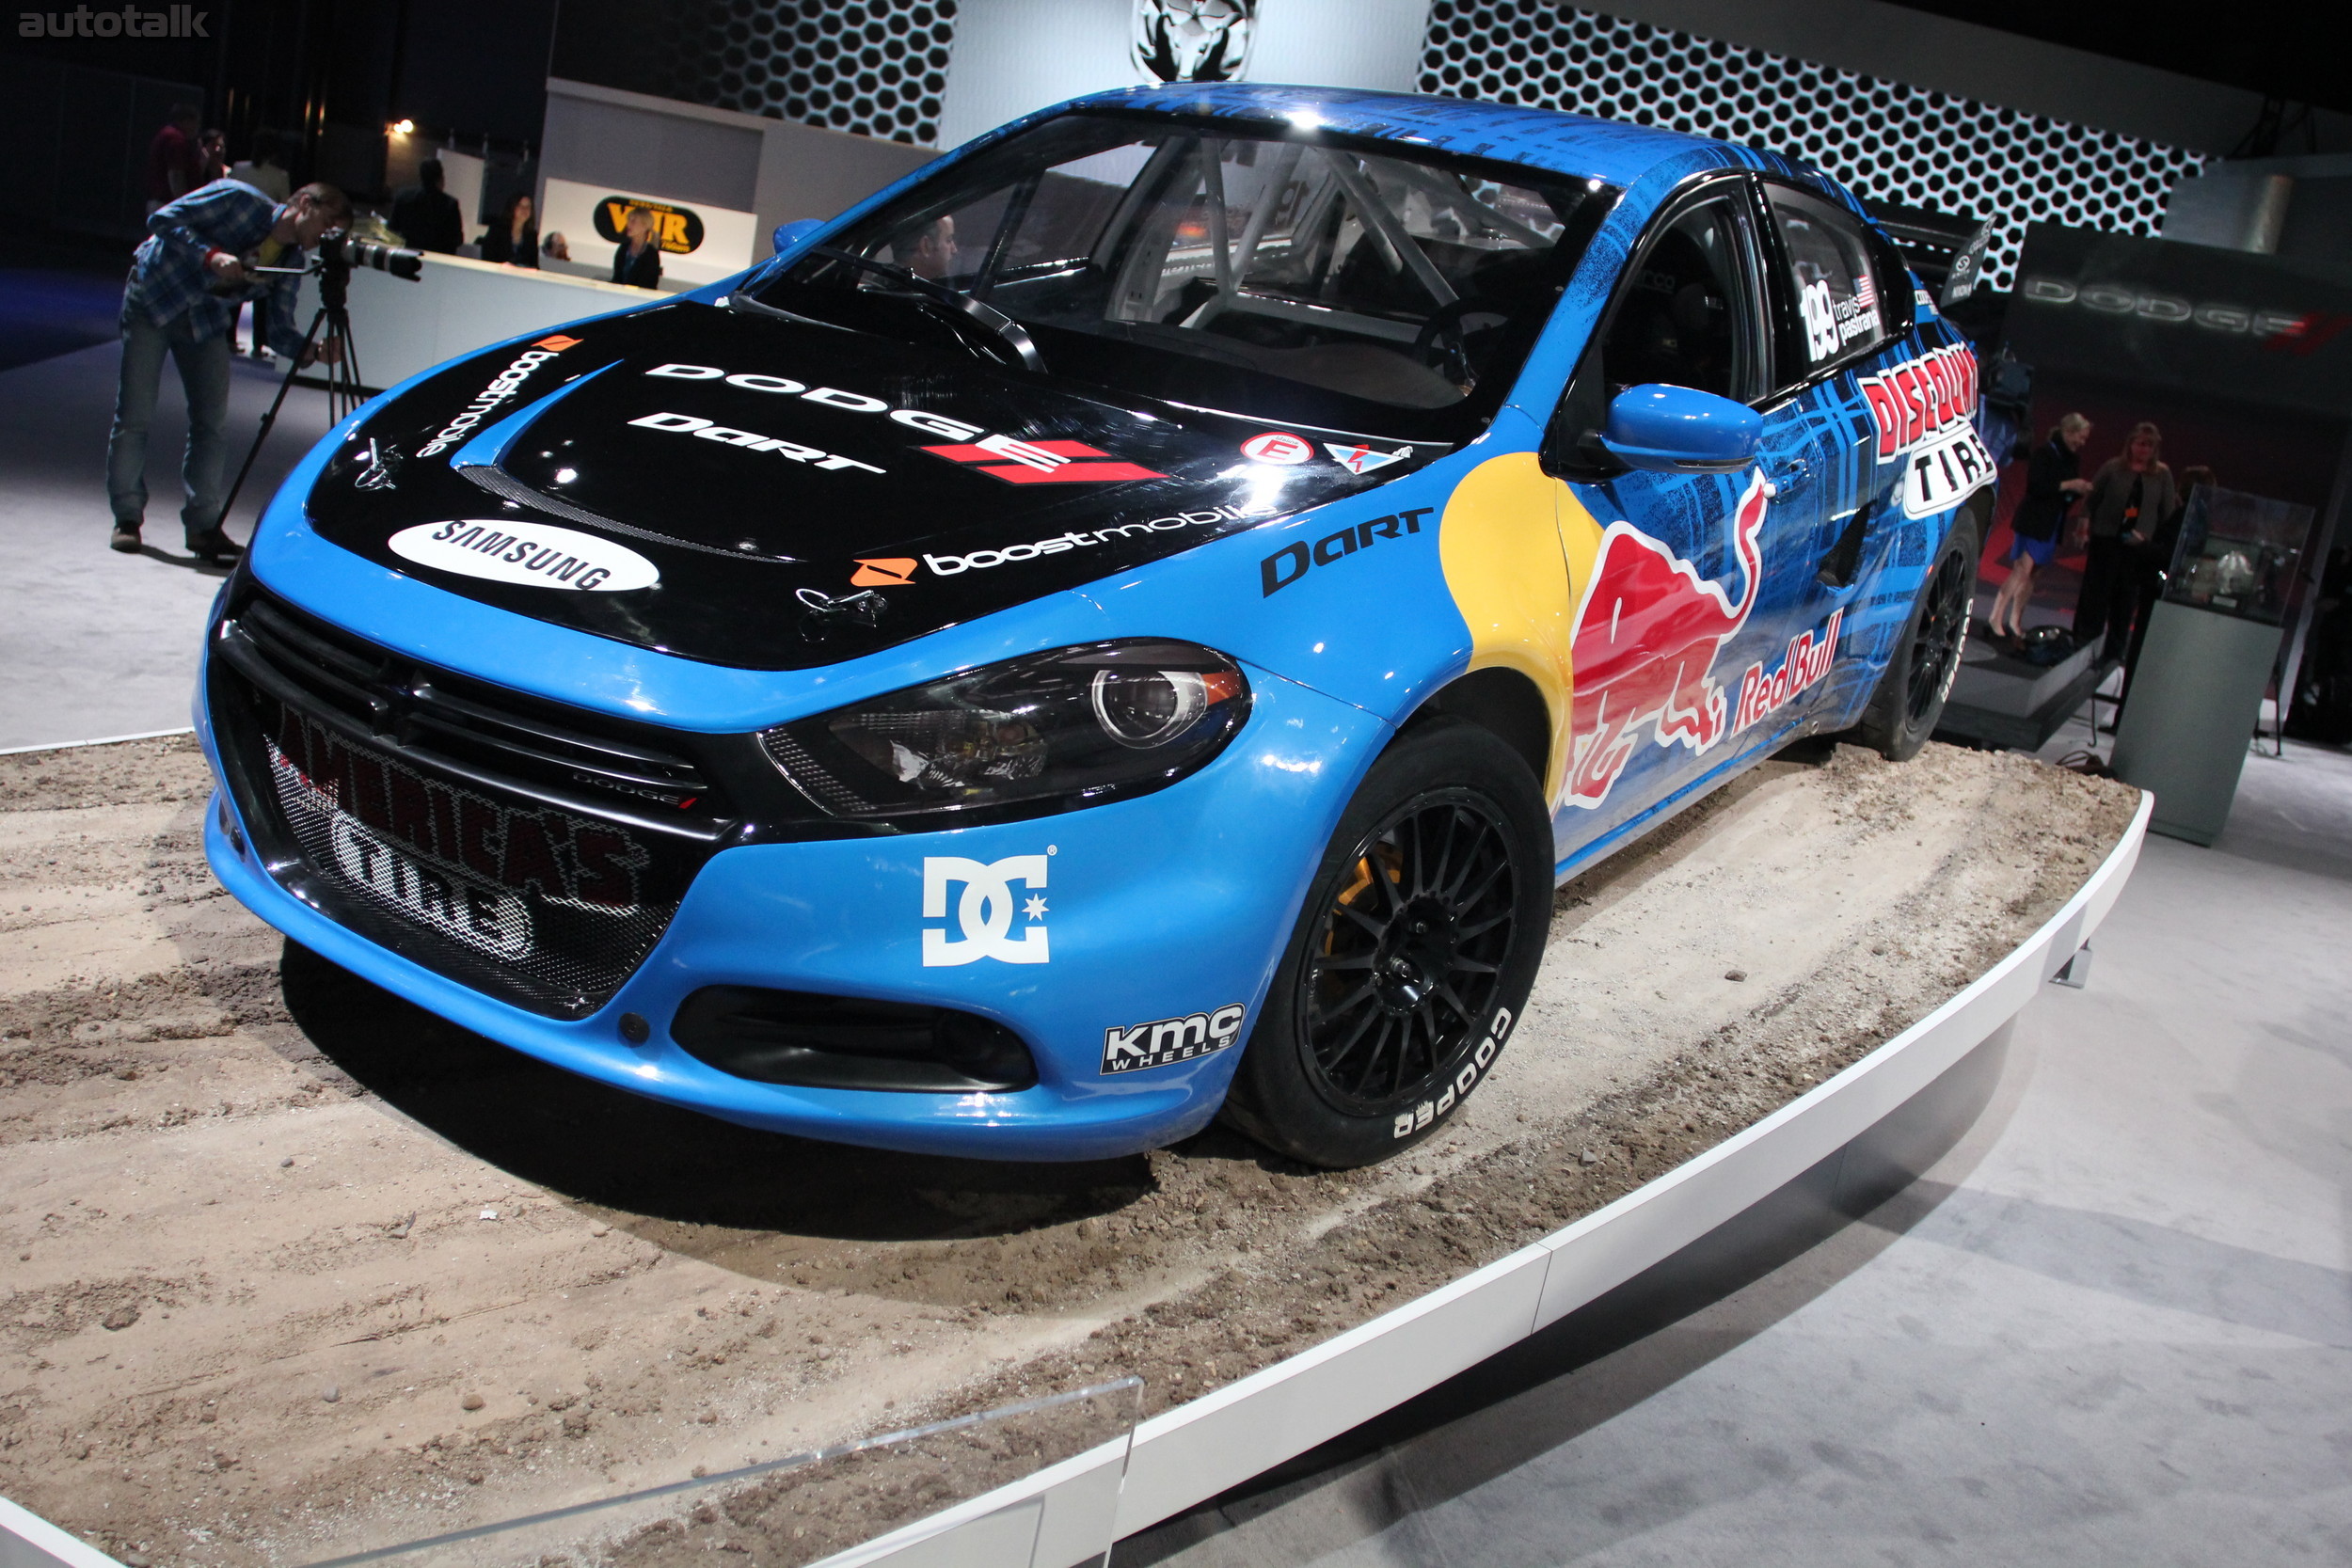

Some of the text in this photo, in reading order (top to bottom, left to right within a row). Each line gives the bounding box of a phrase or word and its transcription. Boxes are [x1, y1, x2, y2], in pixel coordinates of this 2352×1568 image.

[1800, 279, 1840, 362] 199
[1832, 293, 1861, 322] travis
[1838, 309, 1881, 346] pastrana
[2025, 279, 2306, 337] DODGE
[644, 363, 1073, 473] DODGE
[1257, 439, 1299, 460] E
[1915, 434, 1994, 502] TIRE
[432, 520, 612, 591] SAMSUNG
[572, 772, 679, 806] DODGE
[1112, 1036, 1230, 1071] WHEELS
[1393, 1007, 1512, 1139] COOPER
